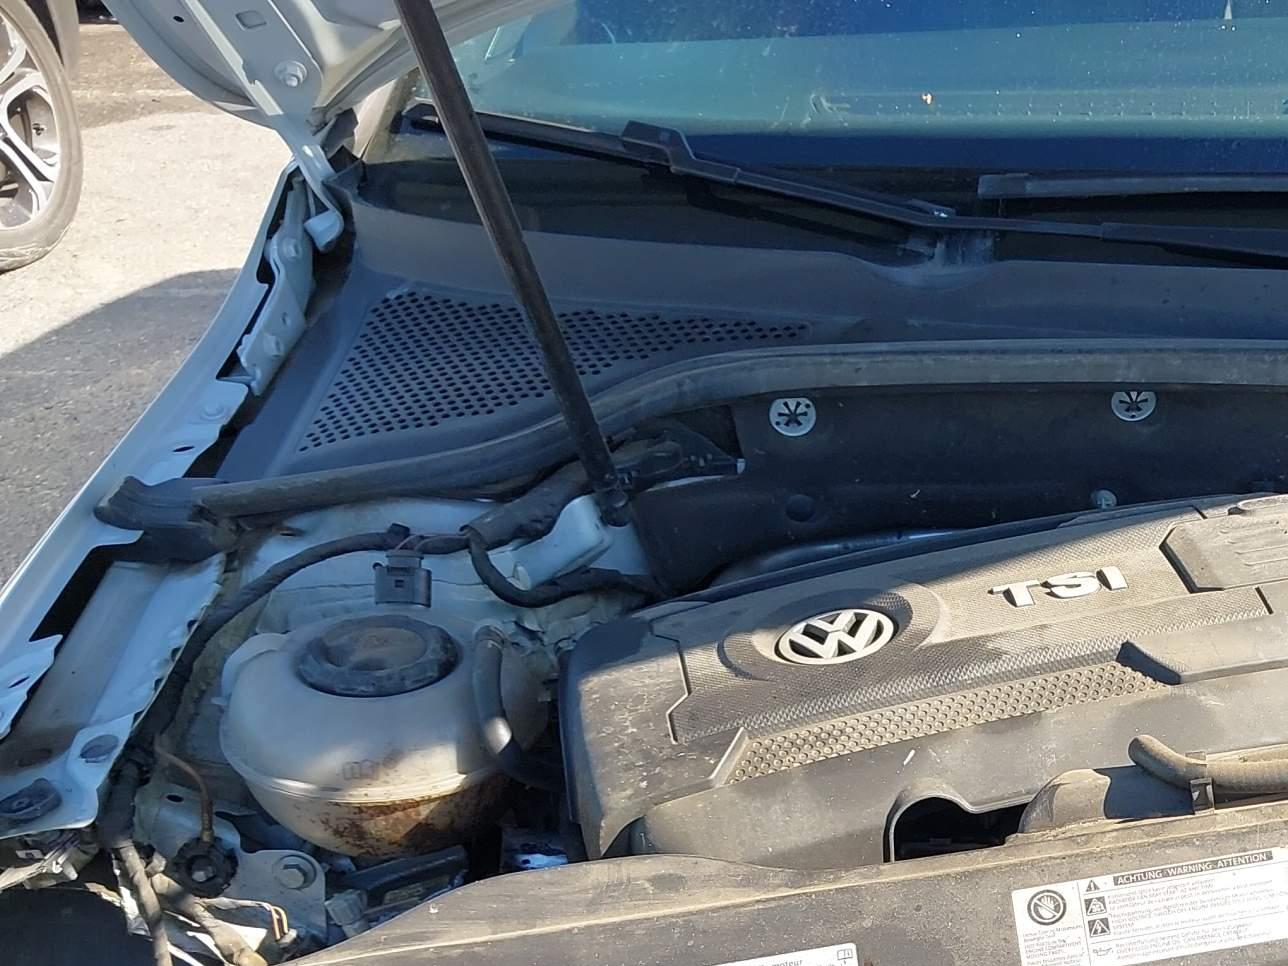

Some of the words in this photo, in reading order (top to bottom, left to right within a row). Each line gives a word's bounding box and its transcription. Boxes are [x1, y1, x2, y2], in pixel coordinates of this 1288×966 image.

[993, 566, 1129, 608] TSI
[1118, 870, 1162, 883] ACHTUNG
[1168, 862, 1212, 875] WARNING
[1218, 853, 1266, 867] ATTENTION
